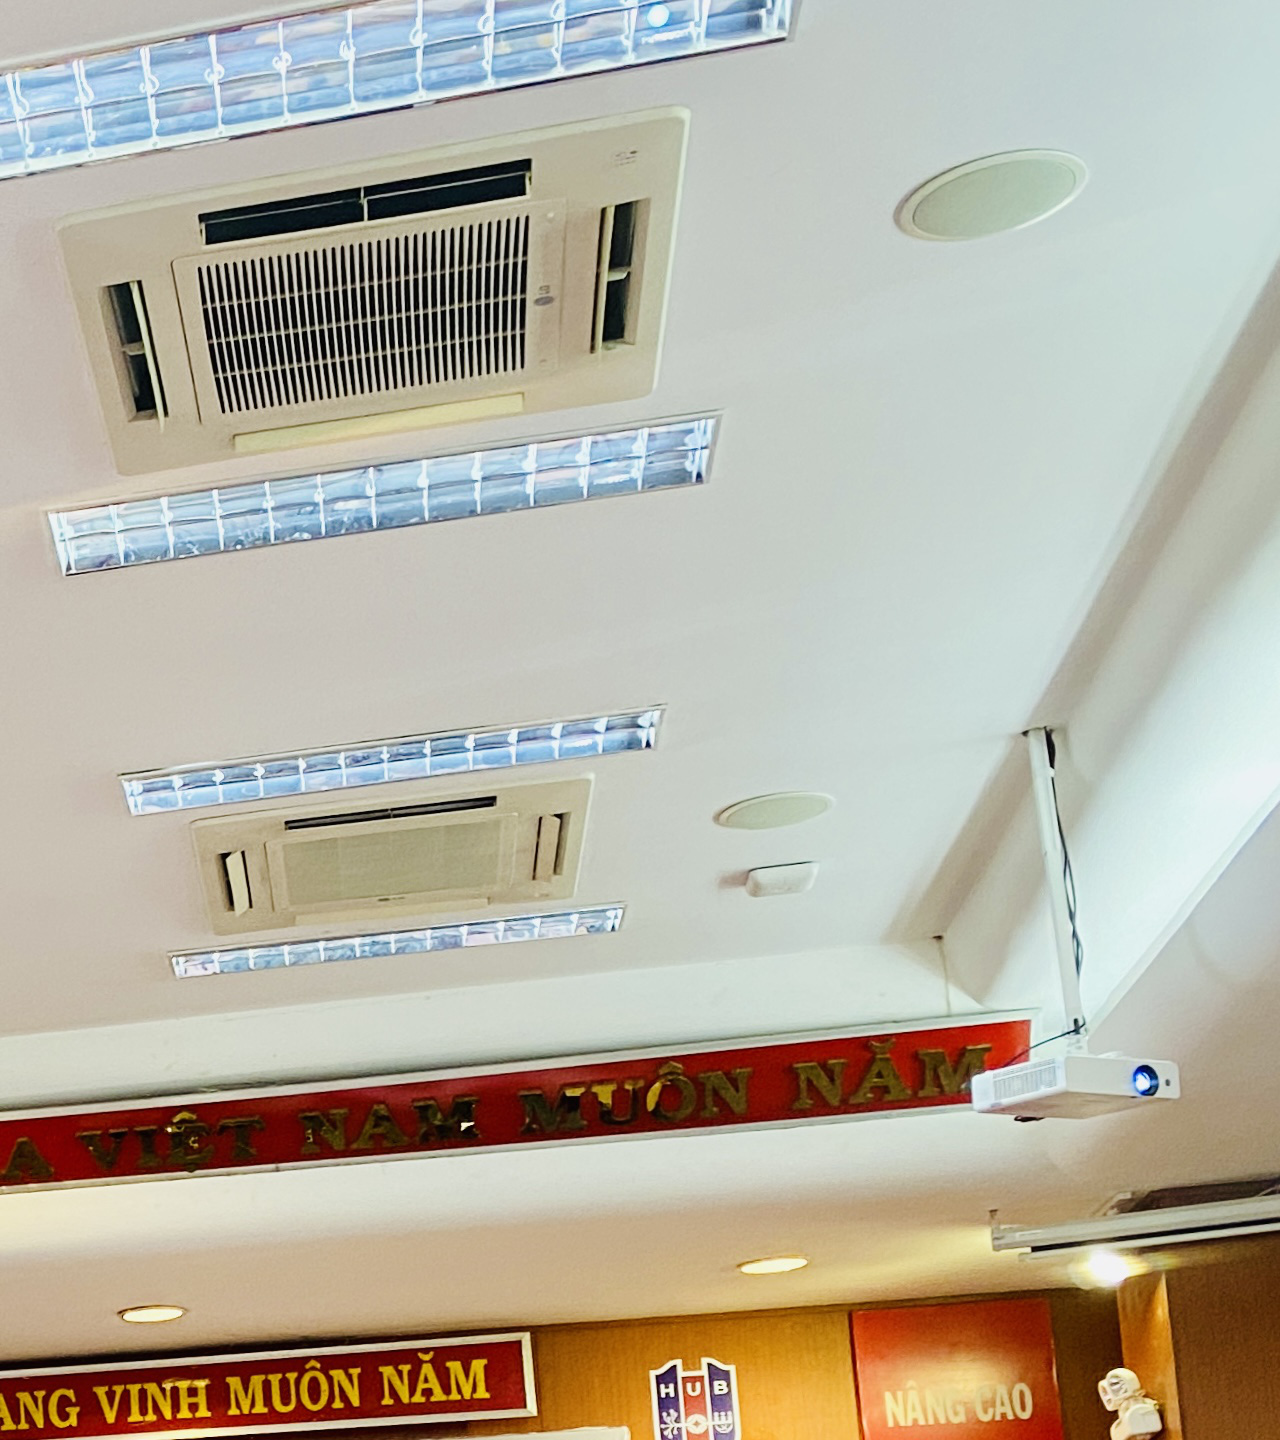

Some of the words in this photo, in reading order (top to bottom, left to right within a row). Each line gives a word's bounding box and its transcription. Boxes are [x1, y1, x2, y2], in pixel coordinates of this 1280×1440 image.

[76, 1112, 267, 1172] VIỆT
[298, 1097, 482, 1154] NAM
[518, 1062, 753, 1135] MUÔN
[792, 1039, 993, 1112] NĂM
[93, 1378, 212, 1425] VINH
[227, 1360, 362, 1416] MUÔN
[379, 1351, 491, 1406] NĂM
[659, 1380, 729, 1398] HUB
[885, 1380, 966, 1427] NÂNG
[975, 1383, 1033, 1422] CAO
